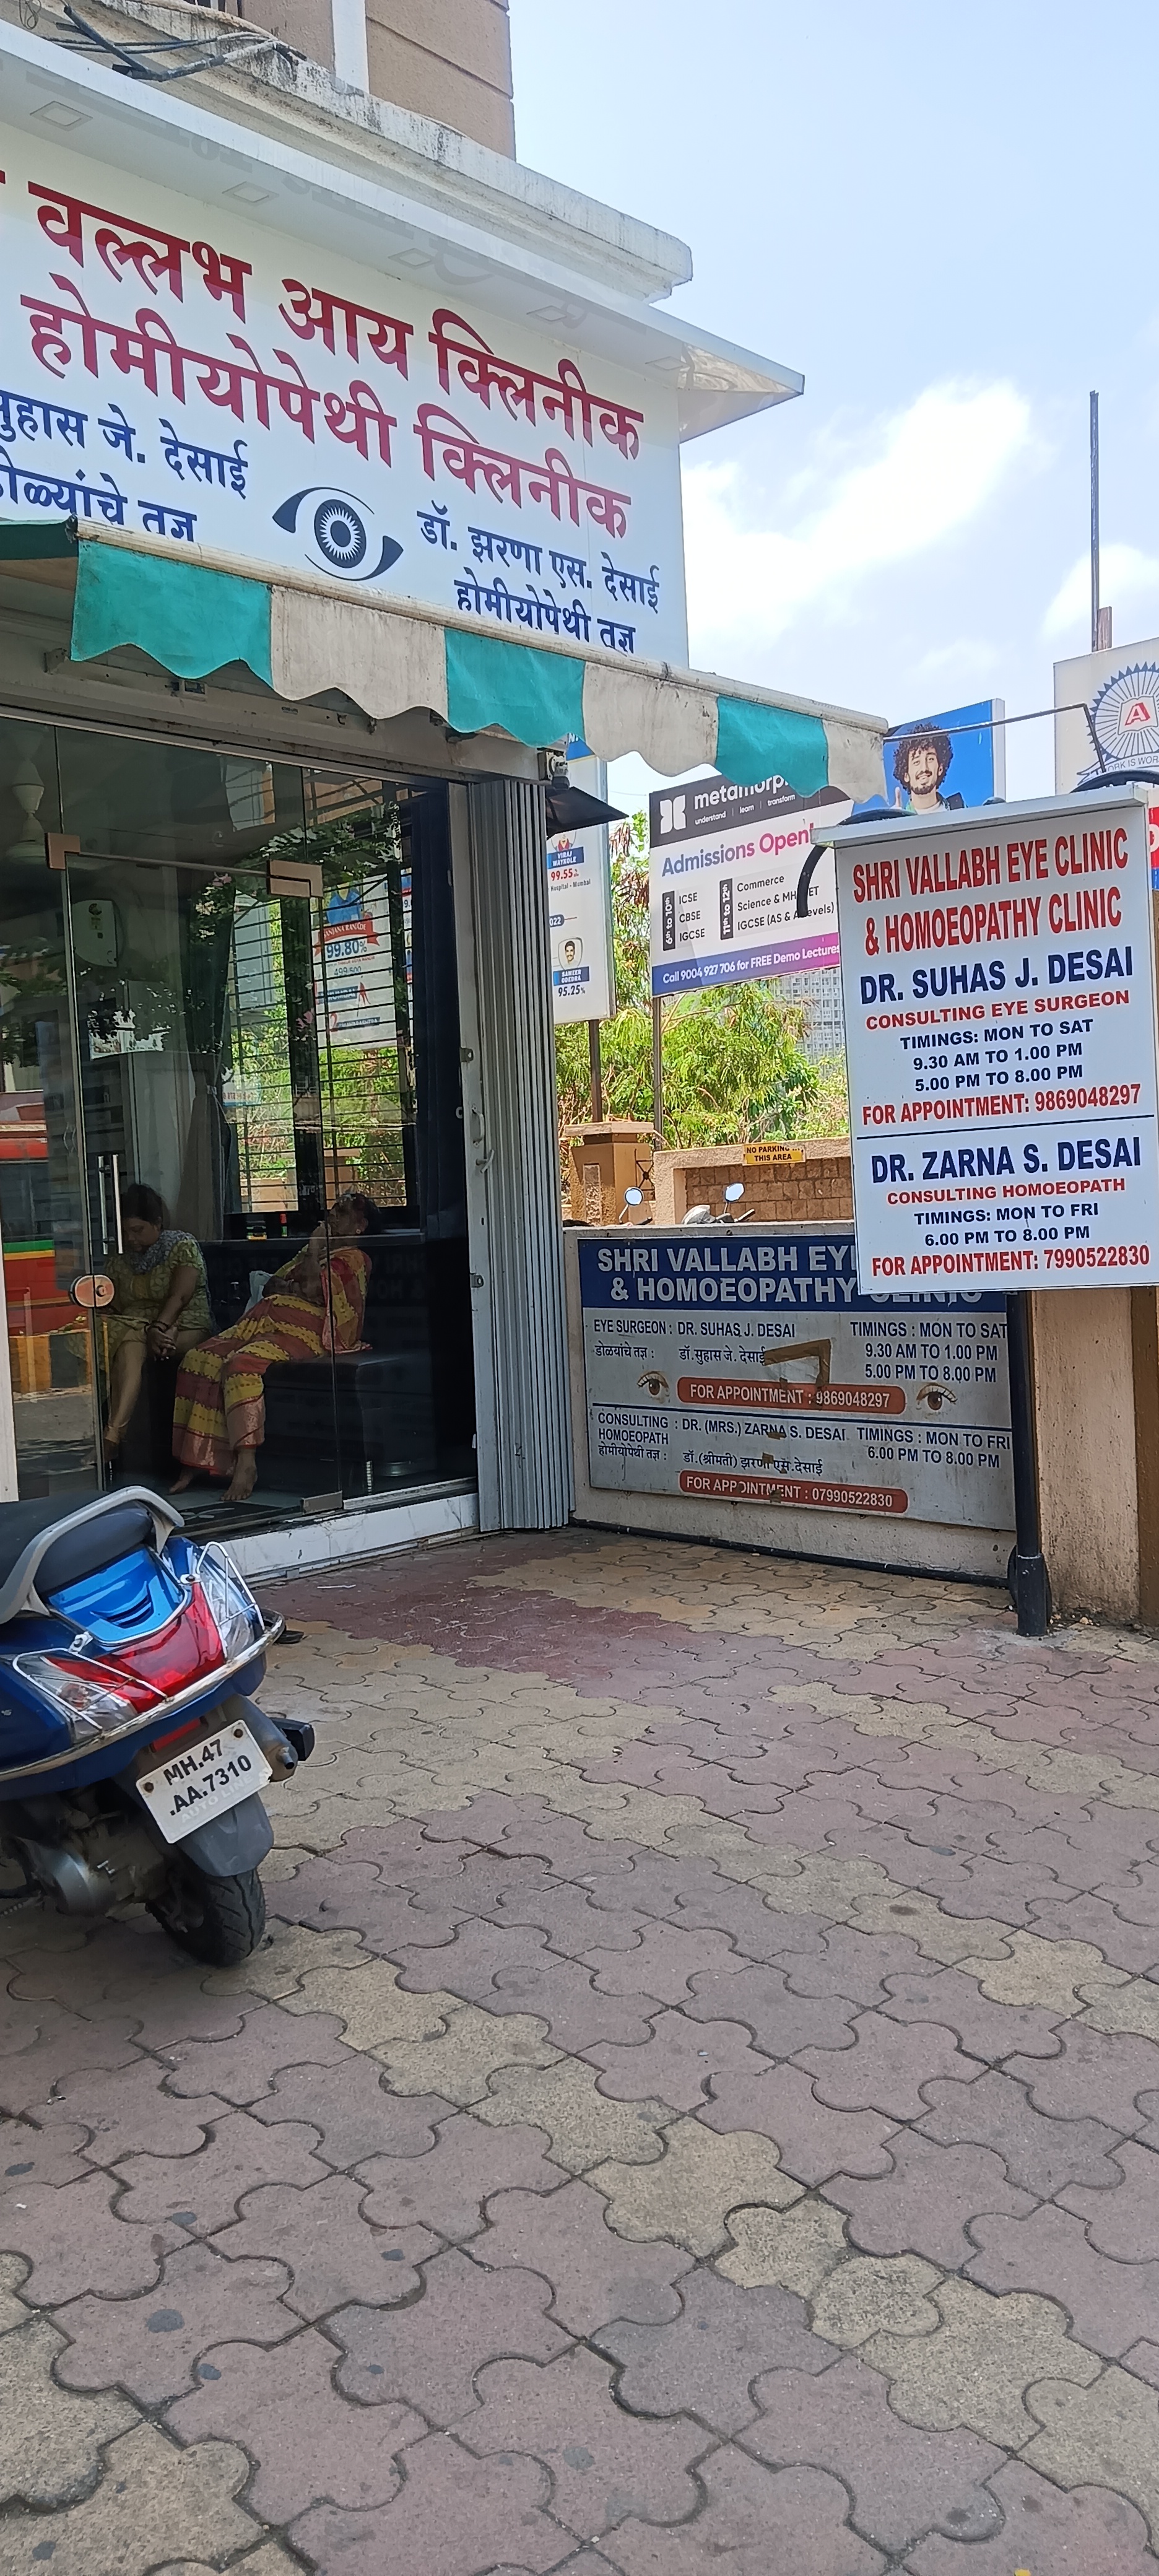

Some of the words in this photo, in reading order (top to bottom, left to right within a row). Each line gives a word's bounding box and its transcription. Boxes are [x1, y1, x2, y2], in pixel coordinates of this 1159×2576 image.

[28, 181, 252, 324] वल्लभ
[279, 278, 414, 381] आय
[428, 308, 644, 460] क्लिनीक
[20, 272, 397, 468] होमीयोपेथी
[413, 403, 632, 538] क्लिनीक
[98, 403, 145, 463] जे.
[159, 418, 248, 499] देसाई
[417, 500, 457, 550] डॉ.
[468, 526, 542, 575] झरणा
[549, 550, 592, 589] एस.
[601, 552, 659, 614] देसाई
[454, 567, 591, 642] होमीयोपेथी
[597, 619, 635, 656] तज्ञ
[1125, 702, 1150, 726] A
[1128, 759, 1135, 767] IS
[1138, 756, 1159, 765] WOR
[695, 775, 788, 809] metamorp
[695, 811, 726, 825] understand
[739, 804, 754, 814] learn
[768, 794, 796, 806] transform
[662, 842, 755, 877] Admissions
[853, 859, 900, 903] SHRI
[905, 845, 1001, 895] VALLABH
[1007, 839, 1048, 882] EYE
[1055, 828, 1128, 876] CLINIC
[722, 884, 730, 903] 12th
[737, 876, 784, 892] Commerce
[664, 897, 672, 917] 10th
[679, 892, 698, 904] ICSE
[737, 898, 771, 912] Science
[774, 894, 780, 903] &
[679, 910, 701, 923] CBSE
[724, 907, 731, 916] to
[737, 916, 765, 931] IGCSE
[767, 913, 782, 926] (AS
[784, 912, 791, 921] &
[866, 917, 879, 955] &
[885, 897, 1041, 953] HOMOEOPATHY
[1049, 886, 1122, 934] CLINIC
[666, 919, 672, 929] to
[680, 928, 705, 942] IGCSE
[723, 920, 731, 935] 11th
[327, 939, 367, 959] 99.80%
[665, 931, 673, 944] 6th
[662, 970, 680, 983] Call
[681, 967, 703, 980] 9004
[704, 964, 718, 976] 927
[719, 961, 735, 973] 706
[737, 959, 749, 970] for
[750, 955, 772, 970] FREE
[774, 951, 801, 965] Demo
[802, 944, 840, 959] Lectures
[860, 973, 903, 1004] DR.
[913, 960, 1005, 998] SUHAS
[1015, 957, 1038, 988] J.
[1048, 946, 1132, 984] DESAI
[558, 985, 585, 997] 95.25%
[866, 1005, 986, 1030] CONSULTING
[991, 1001, 1028, 1017] EYE
[1034, 990, 1129, 1013] SURGEON
[900, 1032, 978, 1050] TIMINGS:
[984, 1026, 1024, 1043] MON
[1059, 1018, 1093, 1035] SAT
[913, 1056, 948, 1071] 9.30
[1015, 1045, 1051, 1061] 1.00
[915, 1077, 949, 1092] 5.00
[1014, 1068, 1052, 1084] 8.00
[863, 1105, 895, 1126] FOR
[901, 1094, 1030, 1123] APPOINTMENT:
[1035, 1084, 1142, 1112] 9869048297
[871, 1153, 914, 1183] DR.
[922, 1146, 1015, 1180] ZARNA
[1023, 1144, 1048, 1173] S.
[1057, 1136, 1141, 1171] DESAI
[887, 1185, 997, 1205] CONSULTING
[1002, 1178, 1126, 1198] HOMOEOPATH
[914, 1209, 991, 1225] TIMINGS:
[996, 1207, 1036, 1221] MON
[1070, 1203, 1099, 1217] FRI
[924, 1232, 960, 1247] 6.00
[1023, 1227, 1058, 1242] 8.00
[597, 1248, 658, 1272] SHRI
[667, 1247, 797, 1272] VALLABH
[809, 1245, 856, 1271] EY
[872, 1256, 906, 1276] FOR
[910, 1250, 1038, 1274] APPOINTMENT:
[1043, 1245, 1150, 1269] 7990522830
[610, 1277, 628, 1300] &
[637, 1277, 856, 1302] HOMOEOPATHY
[594, 1319, 613, 1333] EYE
[616, 1320, 666, 1334] SURGEON
[678, 1321, 697, 1335] DR.
[700, 1322, 740, 1336] SUHAS
[744, 1323, 753, 1337] J.
[758, 1323, 795, 1338] DESAI
[850, 1321, 907, 1337] TIMINGS
[919, 1322, 952, 1338] MON
[981, 1323, 1007, 1339] SAT
[633, 1347, 648, 1360] तज्ञ
[739, 1345, 765, 1366] देसाई
[866, 1343, 892, 1358] 9.30
[945, 1345, 971, 1360] 1.00
[865, 1364, 891, 1378] 5.00
[943, 1366, 971, 1382] 8.00
[690, 1384, 714, 1399] FOR
[717, 1385, 804, 1404] APPOINTMENT
[816, 1390, 890, 1408] 9869048297
[598, 1412, 668, 1428] CONSULTING
[682, 1418, 701, 1431] DR.
[705, 1420, 741, 1437] (MRS.)
[744, 1423, 786, 1438] ZARNA
[790, 1425, 801, 1438] S.
[806, 1427, 845, 1441] DESAI
[599, 1429, 669, 1445] HOMOEOPATH
[857, 1427, 913, 1443] TIMINGS
[926, 1432, 958, 1446] MON
[988, 1435, 1010, 1450] FRI
[646, 1448, 660, 1461] तज्ञ
[868, 1446, 893, 1460] 6.00
[946, 1451, 973, 1466] 8.00
[687, 1476, 711, 1490] FOR
[812, 1489, 892, 1507] 07990522830
[163, 1739, 223, 1786] MH.47
[181, 1797, 219, 1824] AUTO
[221, 1776, 253, 1798] LINE
